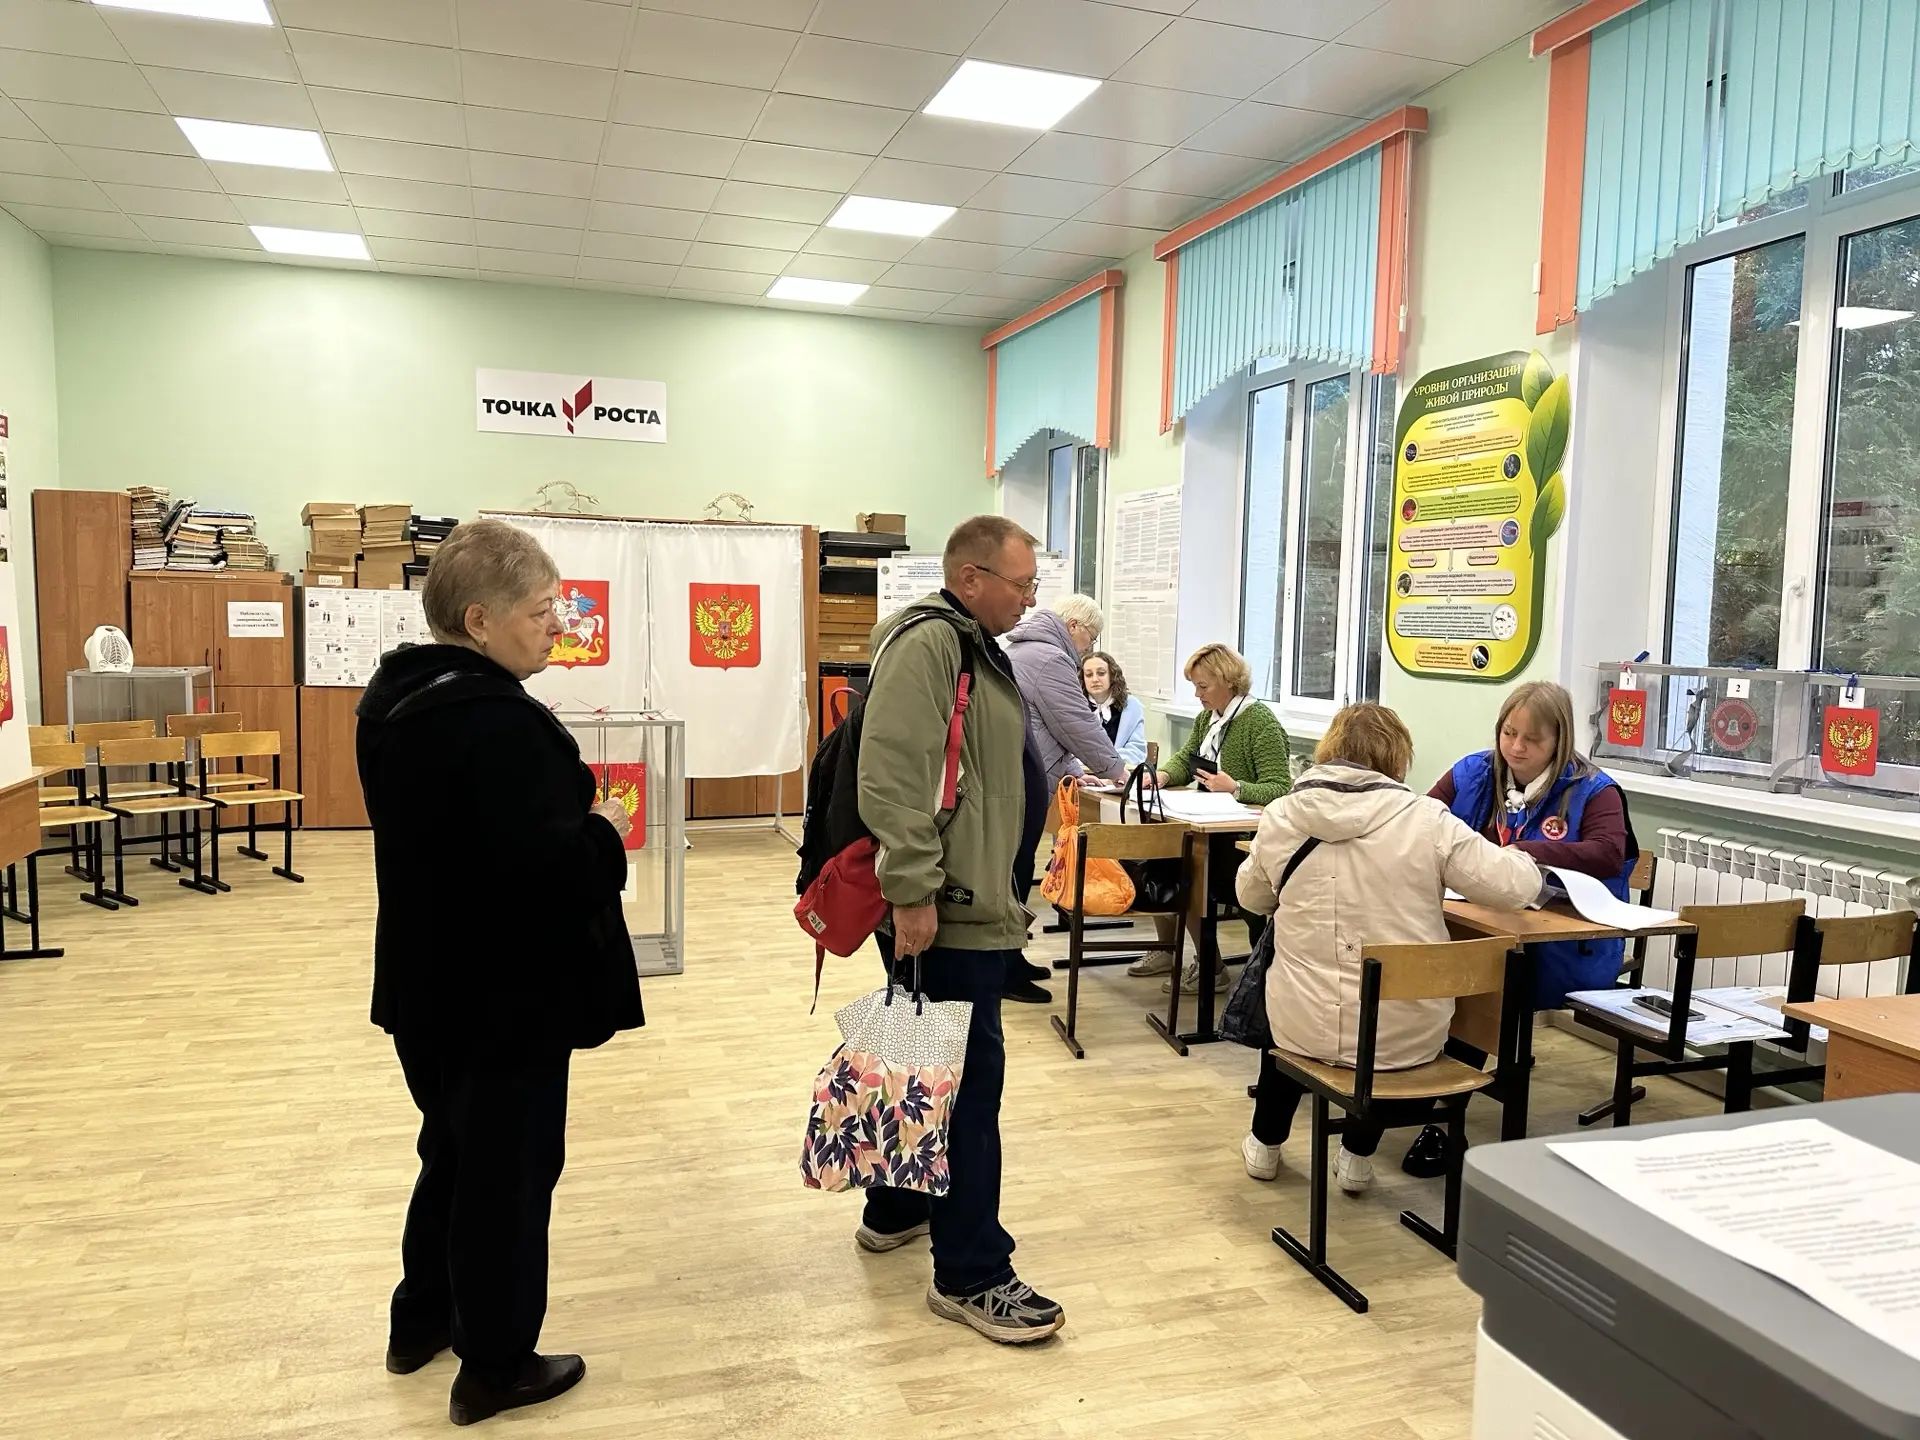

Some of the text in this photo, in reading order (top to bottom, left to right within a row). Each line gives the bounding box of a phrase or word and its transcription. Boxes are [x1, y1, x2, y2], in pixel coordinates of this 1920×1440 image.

[1414, 363, 1521, 397] УРОВНИ ОРГАНИЗАЦИИ
[1425, 381, 1509, 409] ЖИВОЙ ПРИРОДЫ
[482, 398, 661, 425] ТОЧКА РОСТА
[1735, 684, 1741, 693] 2
